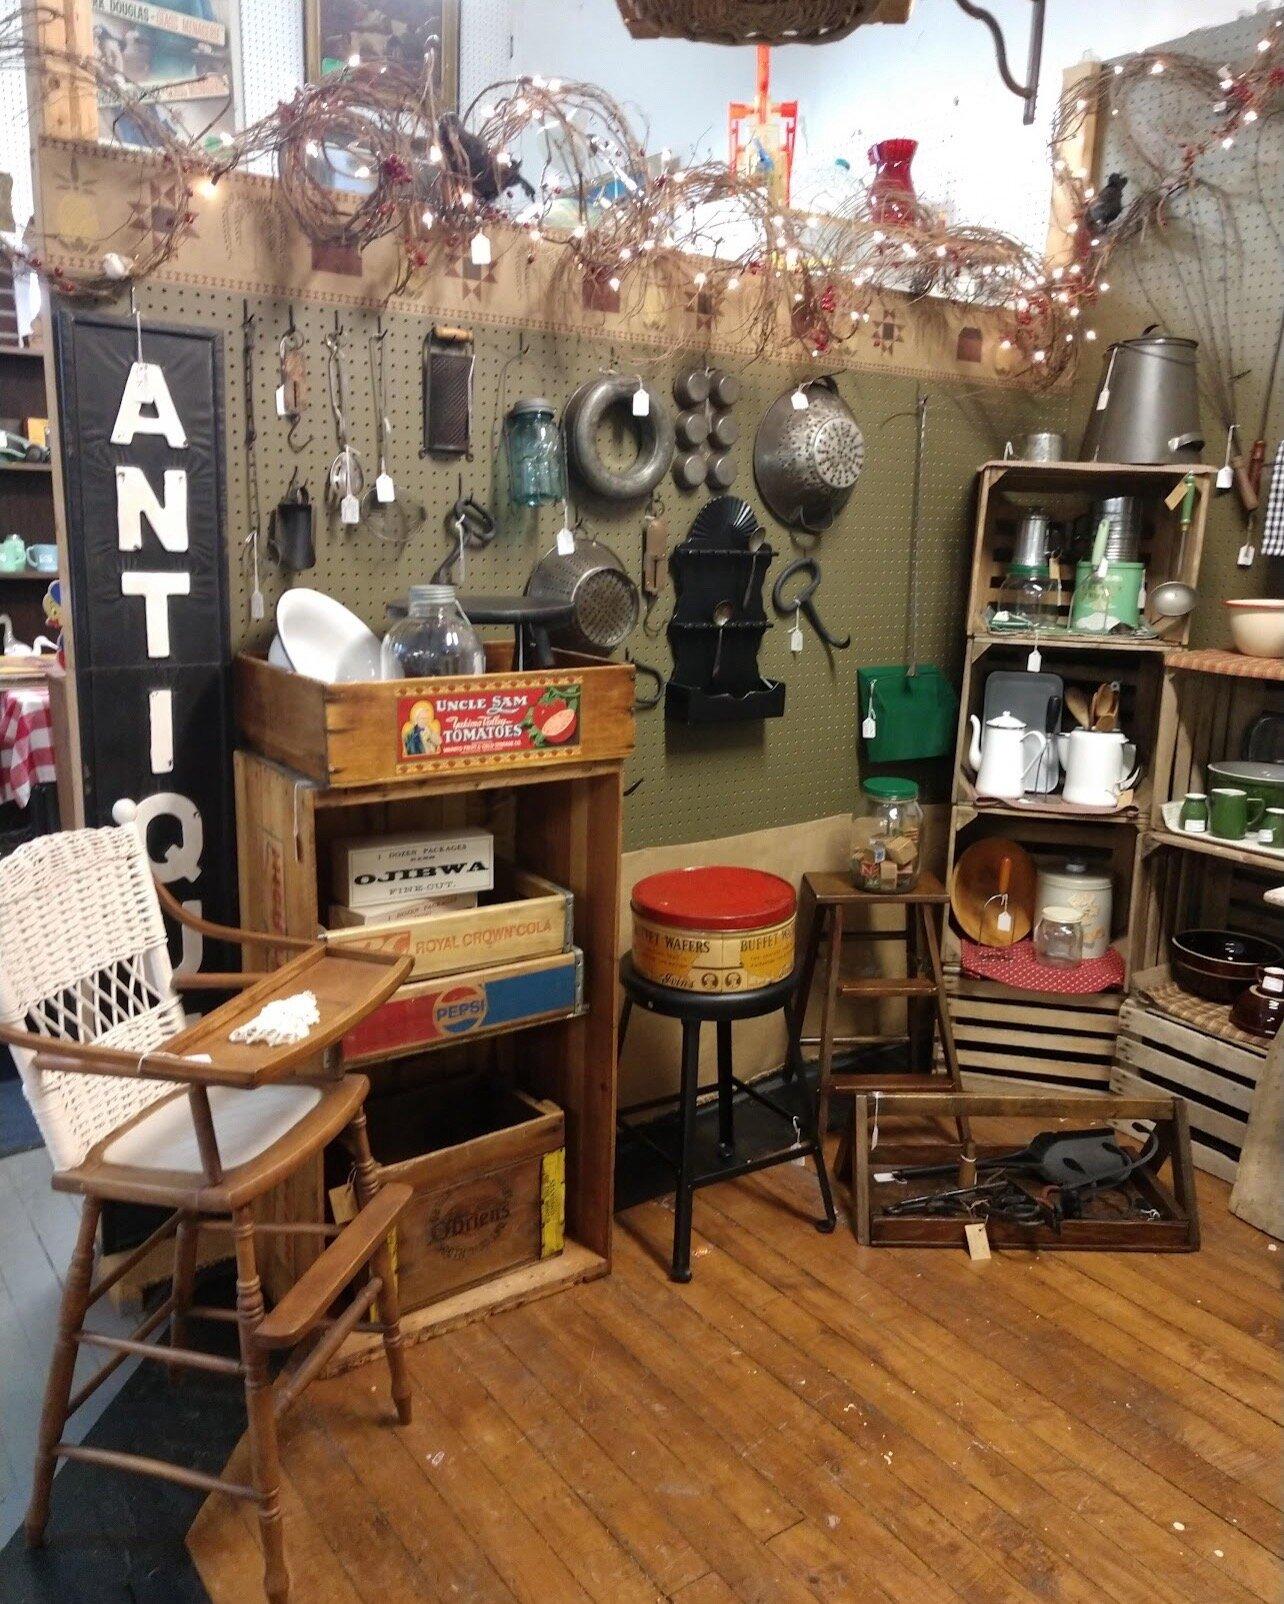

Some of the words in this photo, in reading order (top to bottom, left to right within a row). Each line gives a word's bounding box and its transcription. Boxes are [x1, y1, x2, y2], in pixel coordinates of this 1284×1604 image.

[110, 0, 149, 22] DOUGLAS
[436, 698, 487, 712] UNCLE
[489, 695, 528, 712] SAM
[443, 724, 522, 743] TOMATOES
[424, 843, 467, 855] PACKAGES
[354, 860, 489, 886] OJIBWA
[415, 935, 460, 954] ROYAL
[462, 928, 512, 946] CROWN
[513, 919, 552, 936] COLA
[665, 935, 710, 953] WAFERS
[740, 933, 778, 952] BUFFET
[437, 999, 485, 1021] PEPSI
